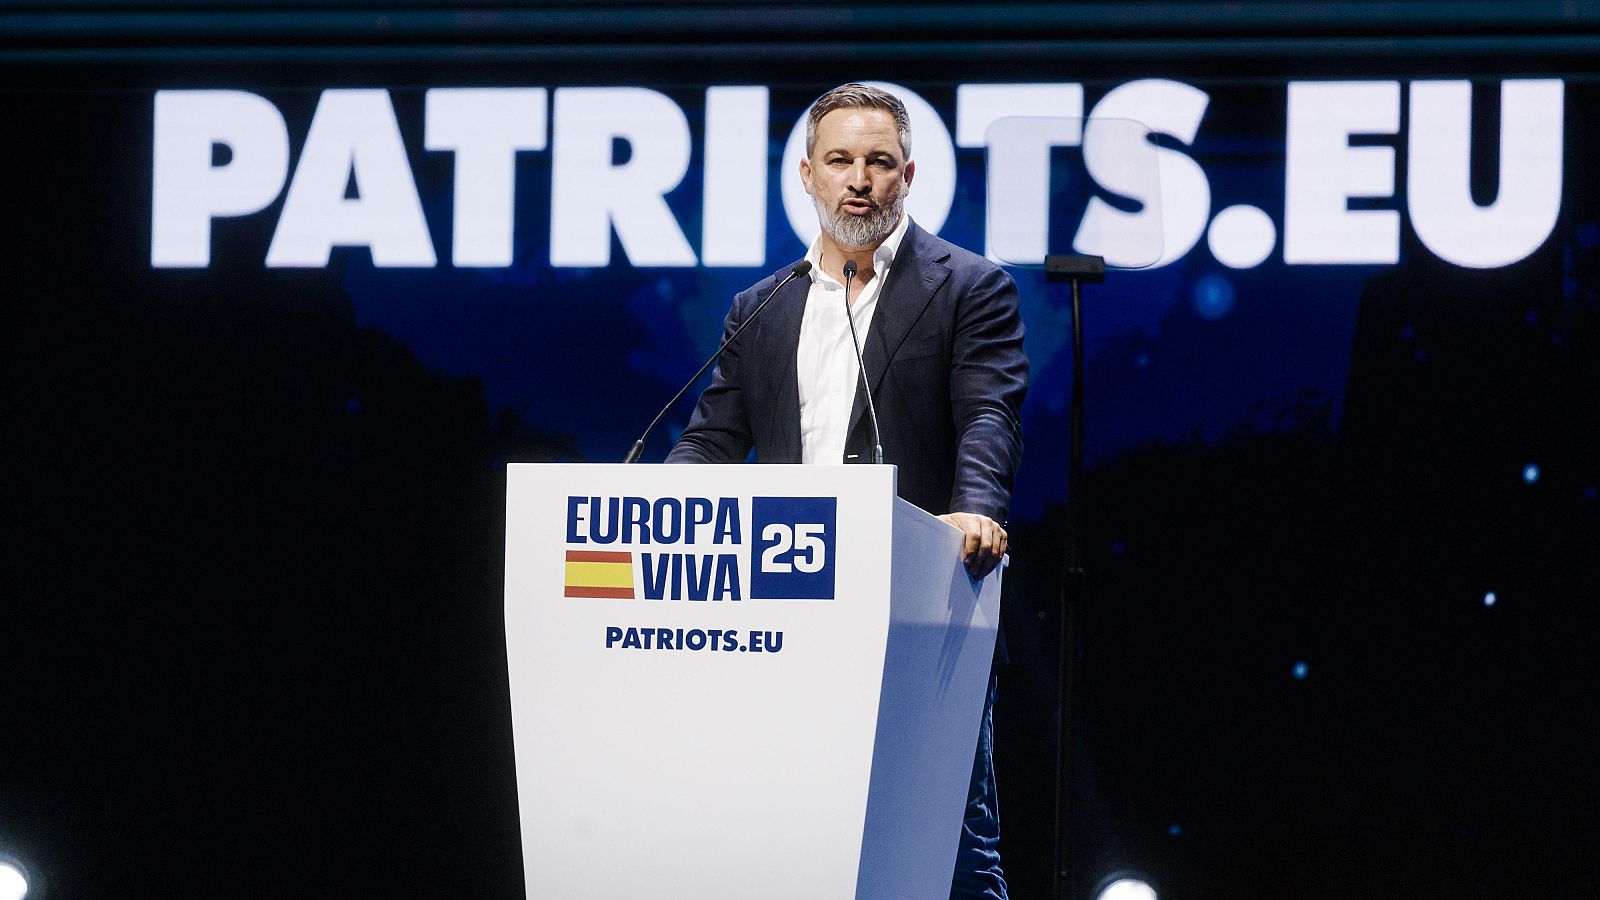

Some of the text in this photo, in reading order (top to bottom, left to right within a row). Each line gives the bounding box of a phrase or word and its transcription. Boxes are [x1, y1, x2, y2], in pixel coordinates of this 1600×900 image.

[566, 496, 742, 545] EUROPA
[761, 523, 826, 573] 25
[641, 552, 742, 602] VIVA
[605, 626, 784, 653] PATRIOTS.EU
